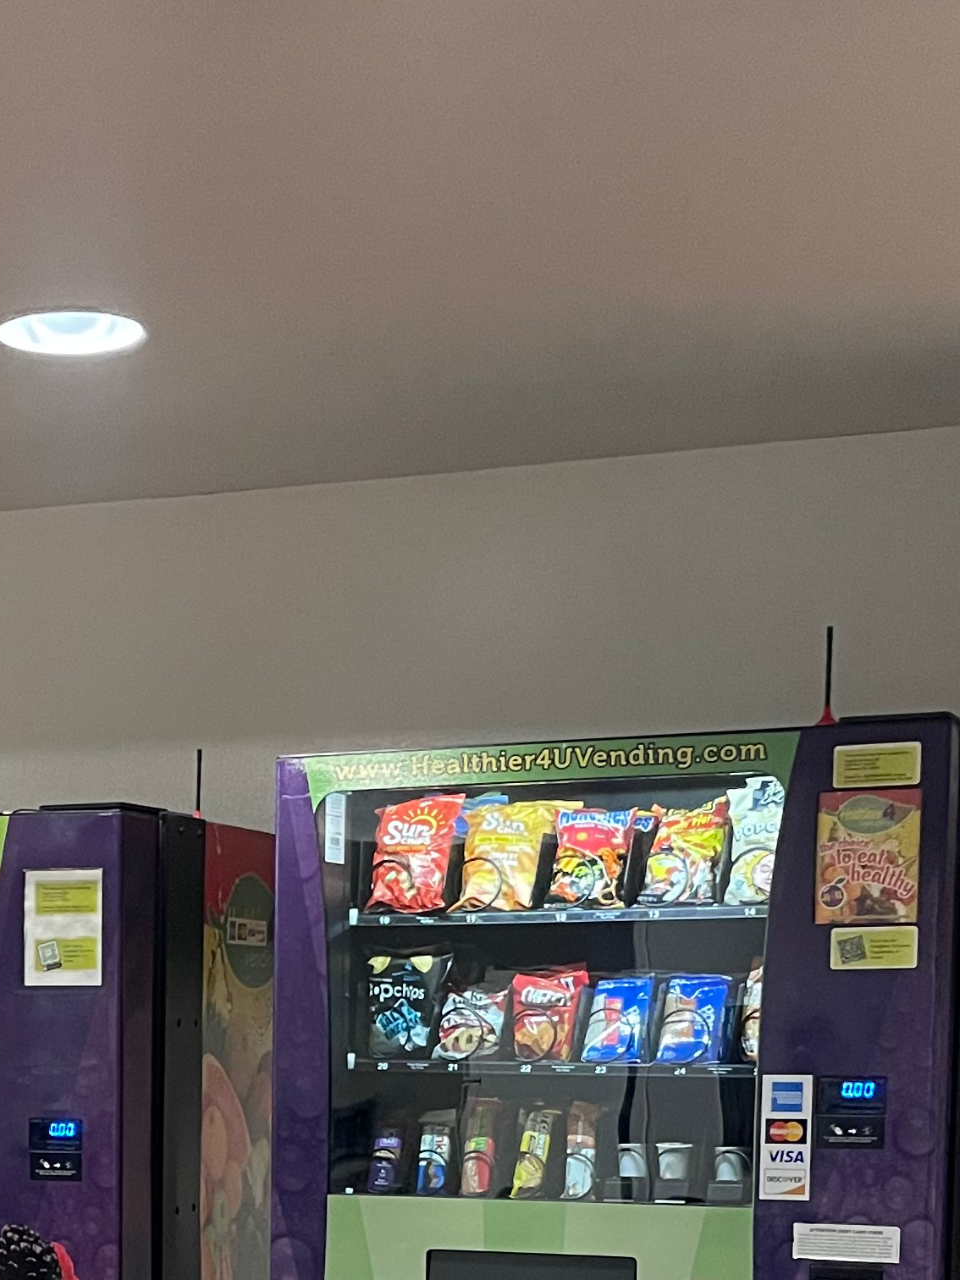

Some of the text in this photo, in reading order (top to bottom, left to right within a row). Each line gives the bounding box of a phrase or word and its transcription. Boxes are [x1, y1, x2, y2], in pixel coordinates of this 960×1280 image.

[382, 821, 432, 845] Sun
[733, 821, 778, 842] POPC
[834, 849, 887, 865] to eat
[849, 863, 915, 897] healthy
[744, 907, 757, 917] 14
[768, 1150, 805, 1163] VISA
[766, 1175, 803, 1184] DISCOVER
